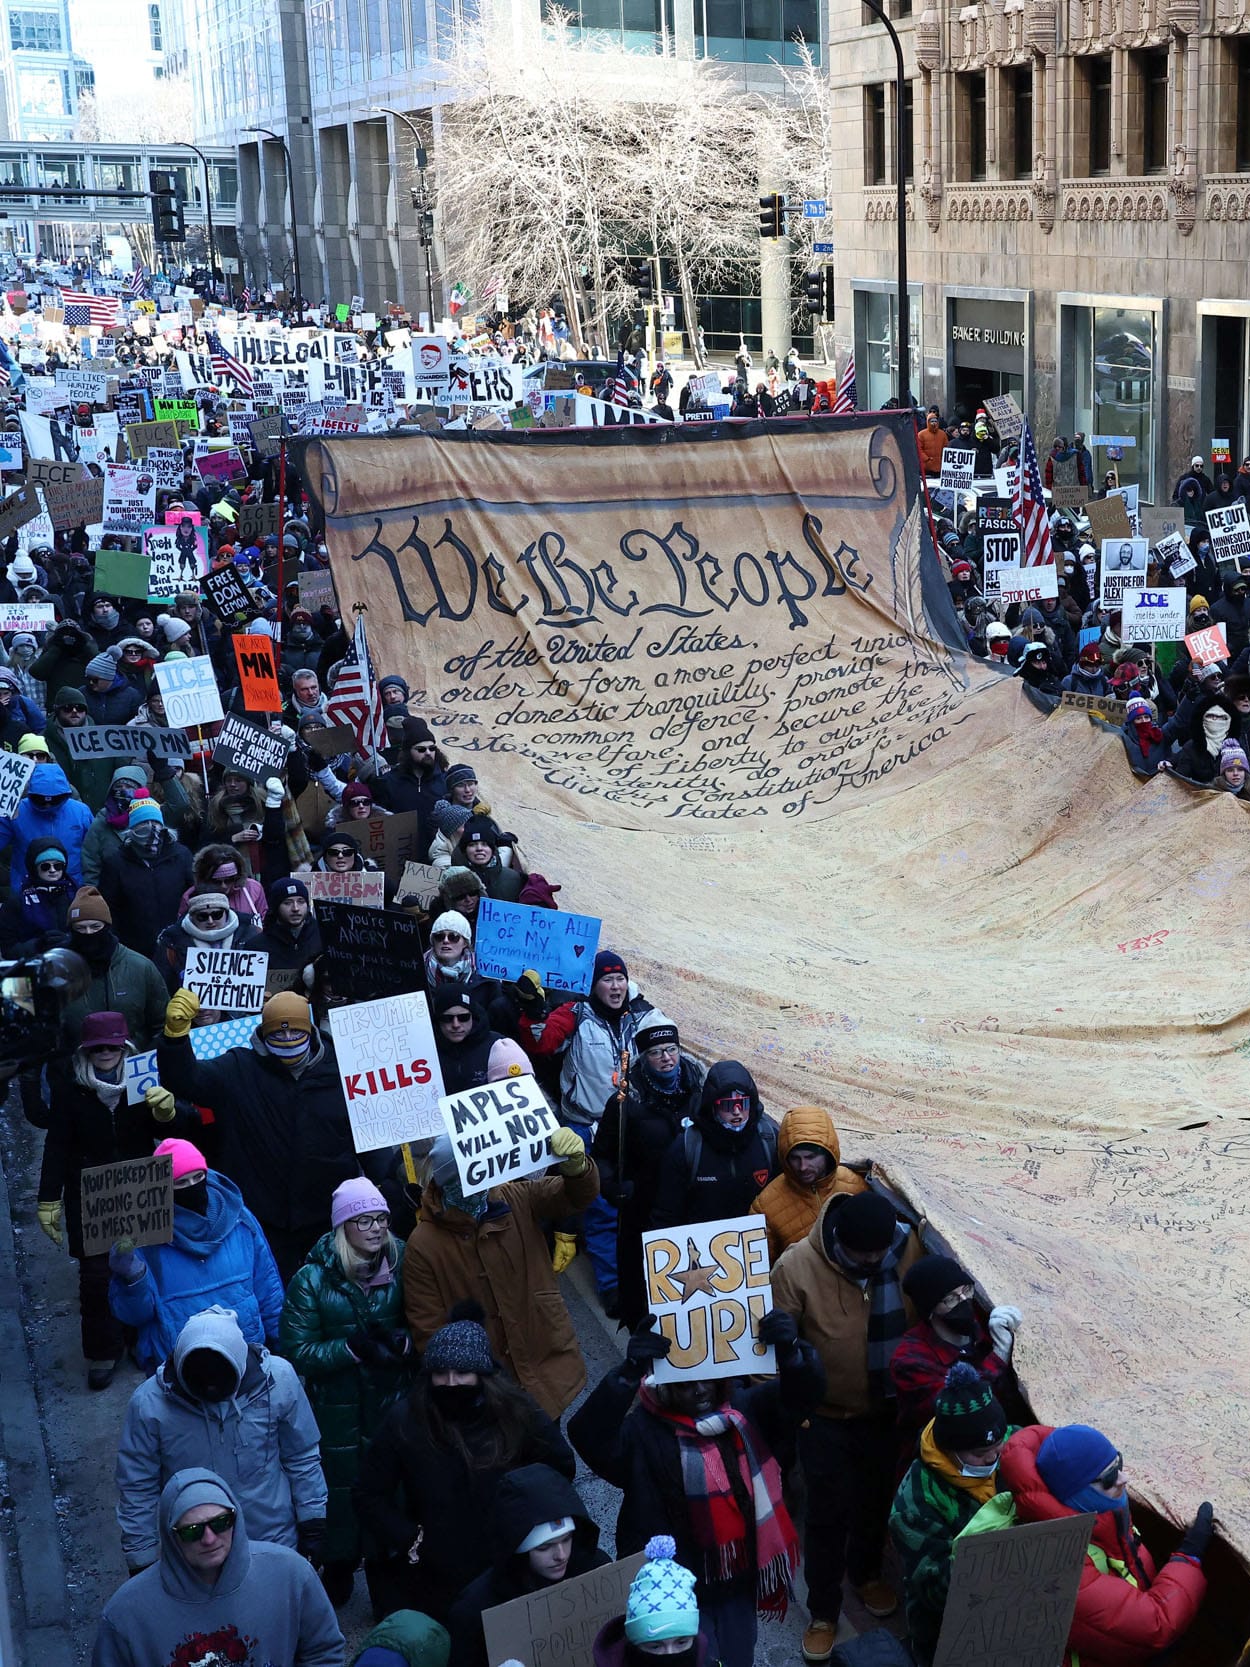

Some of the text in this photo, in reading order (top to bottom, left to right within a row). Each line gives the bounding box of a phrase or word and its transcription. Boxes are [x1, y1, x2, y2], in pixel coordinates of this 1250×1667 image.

[953, 326, 1024, 346] BAKER BUILDING
[57, 372, 80, 381] ICE
[141, 368, 161, 379] STOP
[70, 390, 96, 399] PEOPLE
[371, 391, 384, 405] ICE
[685, 412, 713, 420] PRETTI
[134, 426, 174, 442] FUCK
[944, 450, 974, 465] ICE OUT
[32, 464, 75, 483] ICE
[940, 480, 953, 488] FOR
[942, 470, 972, 480] MINNESOTA
[243, 508, 276, 519] ICE
[1208, 507, 1246, 529] ICE OUT
[243, 521, 278, 535] OUT
[1213, 531, 1250, 547] MINNESOTA
[986, 538, 1018, 562] STOP
[1215, 548, 1231, 559] FOR
[207, 569, 235, 591] FREE
[351, 512, 873, 630] We People
[1103, 575, 1145, 587] JUSTICE FOR
[213, 583, 242, 605] DON
[1025, 588, 1042, 599] ICE
[1135, 592, 1169, 608] ICE
[220, 596, 249, 617] LEMON
[1135, 611, 1156, 620] melts
[1128, 626, 1180, 641] RESISTANCE
[239, 653, 274, 679] MN
[441, 634, 839, 703] order more perfect
[443, 633, 642, 681] of United
[163, 660, 214, 692] ICE
[167, 691, 219, 725] OUT
[494, 699, 620, 726] domestic
[531, 729, 634, 745] common
[776, 676, 884, 723] promote
[1065, 694, 1094, 709] ICE
[702, 682, 923, 750] and secure the
[70, 729, 192, 755] ICE GTFO MN
[219, 730, 283, 769] MAKE AMERICA
[226, 718, 286, 757] IMMIGRANTS
[2, 758, 29, 779] ARE
[232, 752, 264, 774] GREAT
[682, 757, 858, 803] Constitution
[663, 791, 816, 819] States of
[347, 912, 385, 930] you're
[482, 901, 593, 939] Here For ALL
[339, 927, 389, 948] ANGRY
[195, 952, 255, 978] SILENCE
[480, 938, 561, 968] Community
[545, 972, 586, 990] Fear!
[187, 981, 264, 1009] STATEMENT
[351, 1026, 413, 1071] ICE
[345, 1059, 432, 1101] KILLS
[354, 1086, 428, 1125] MOMS
[449, 1082, 530, 1135] MPLS
[354, 1107, 446, 1149] NURSES
[456, 1108, 552, 1159] WILL NOT
[83, 1159, 170, 1195] YOU PICKED THE
[466, 1146, 521, 1186] GIVE
[86, 1185, 168, 1218] WRONG CITY
[84, 1210, 170, 1239] TO MESS WITH
[660, 1294, 769, 1369] UP!
[582, 1568, 626, 1609] NOT
